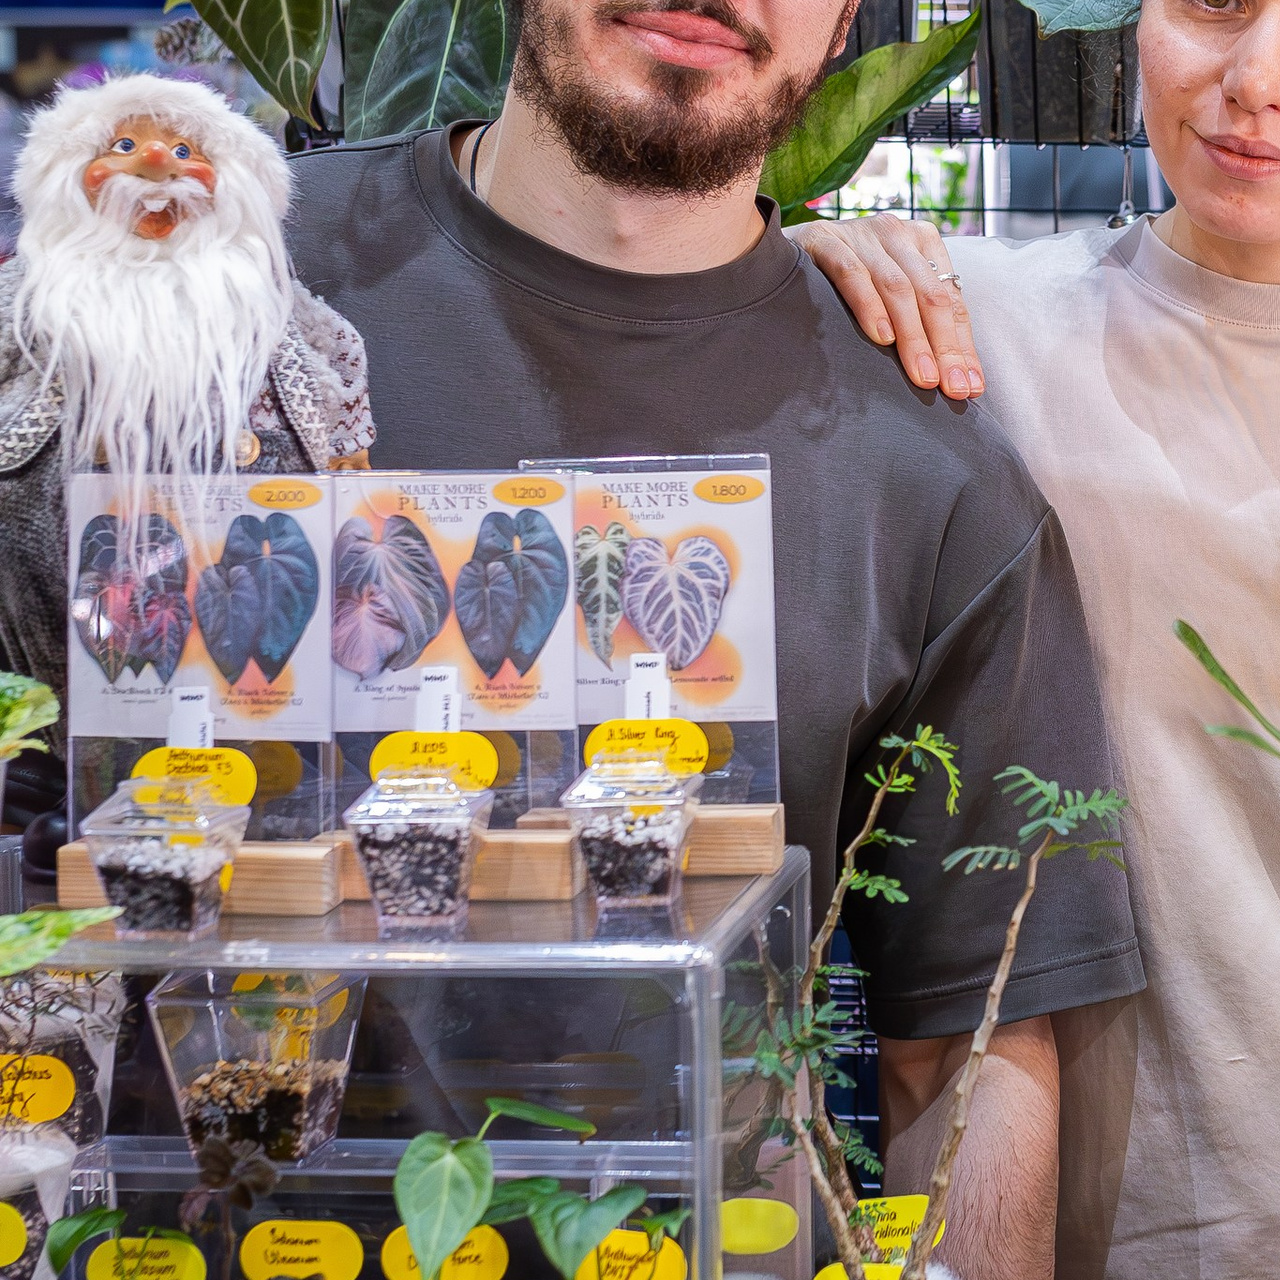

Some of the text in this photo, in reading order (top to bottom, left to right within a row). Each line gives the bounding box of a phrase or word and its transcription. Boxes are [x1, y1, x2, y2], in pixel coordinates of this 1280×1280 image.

[398, 483, 487, 496] MAKE MORE
[602, 481, 688, 494] MAKE MORE
[399, 496, 488, 511] PLANTS
[602, 494, 689, 509] PLANTS
